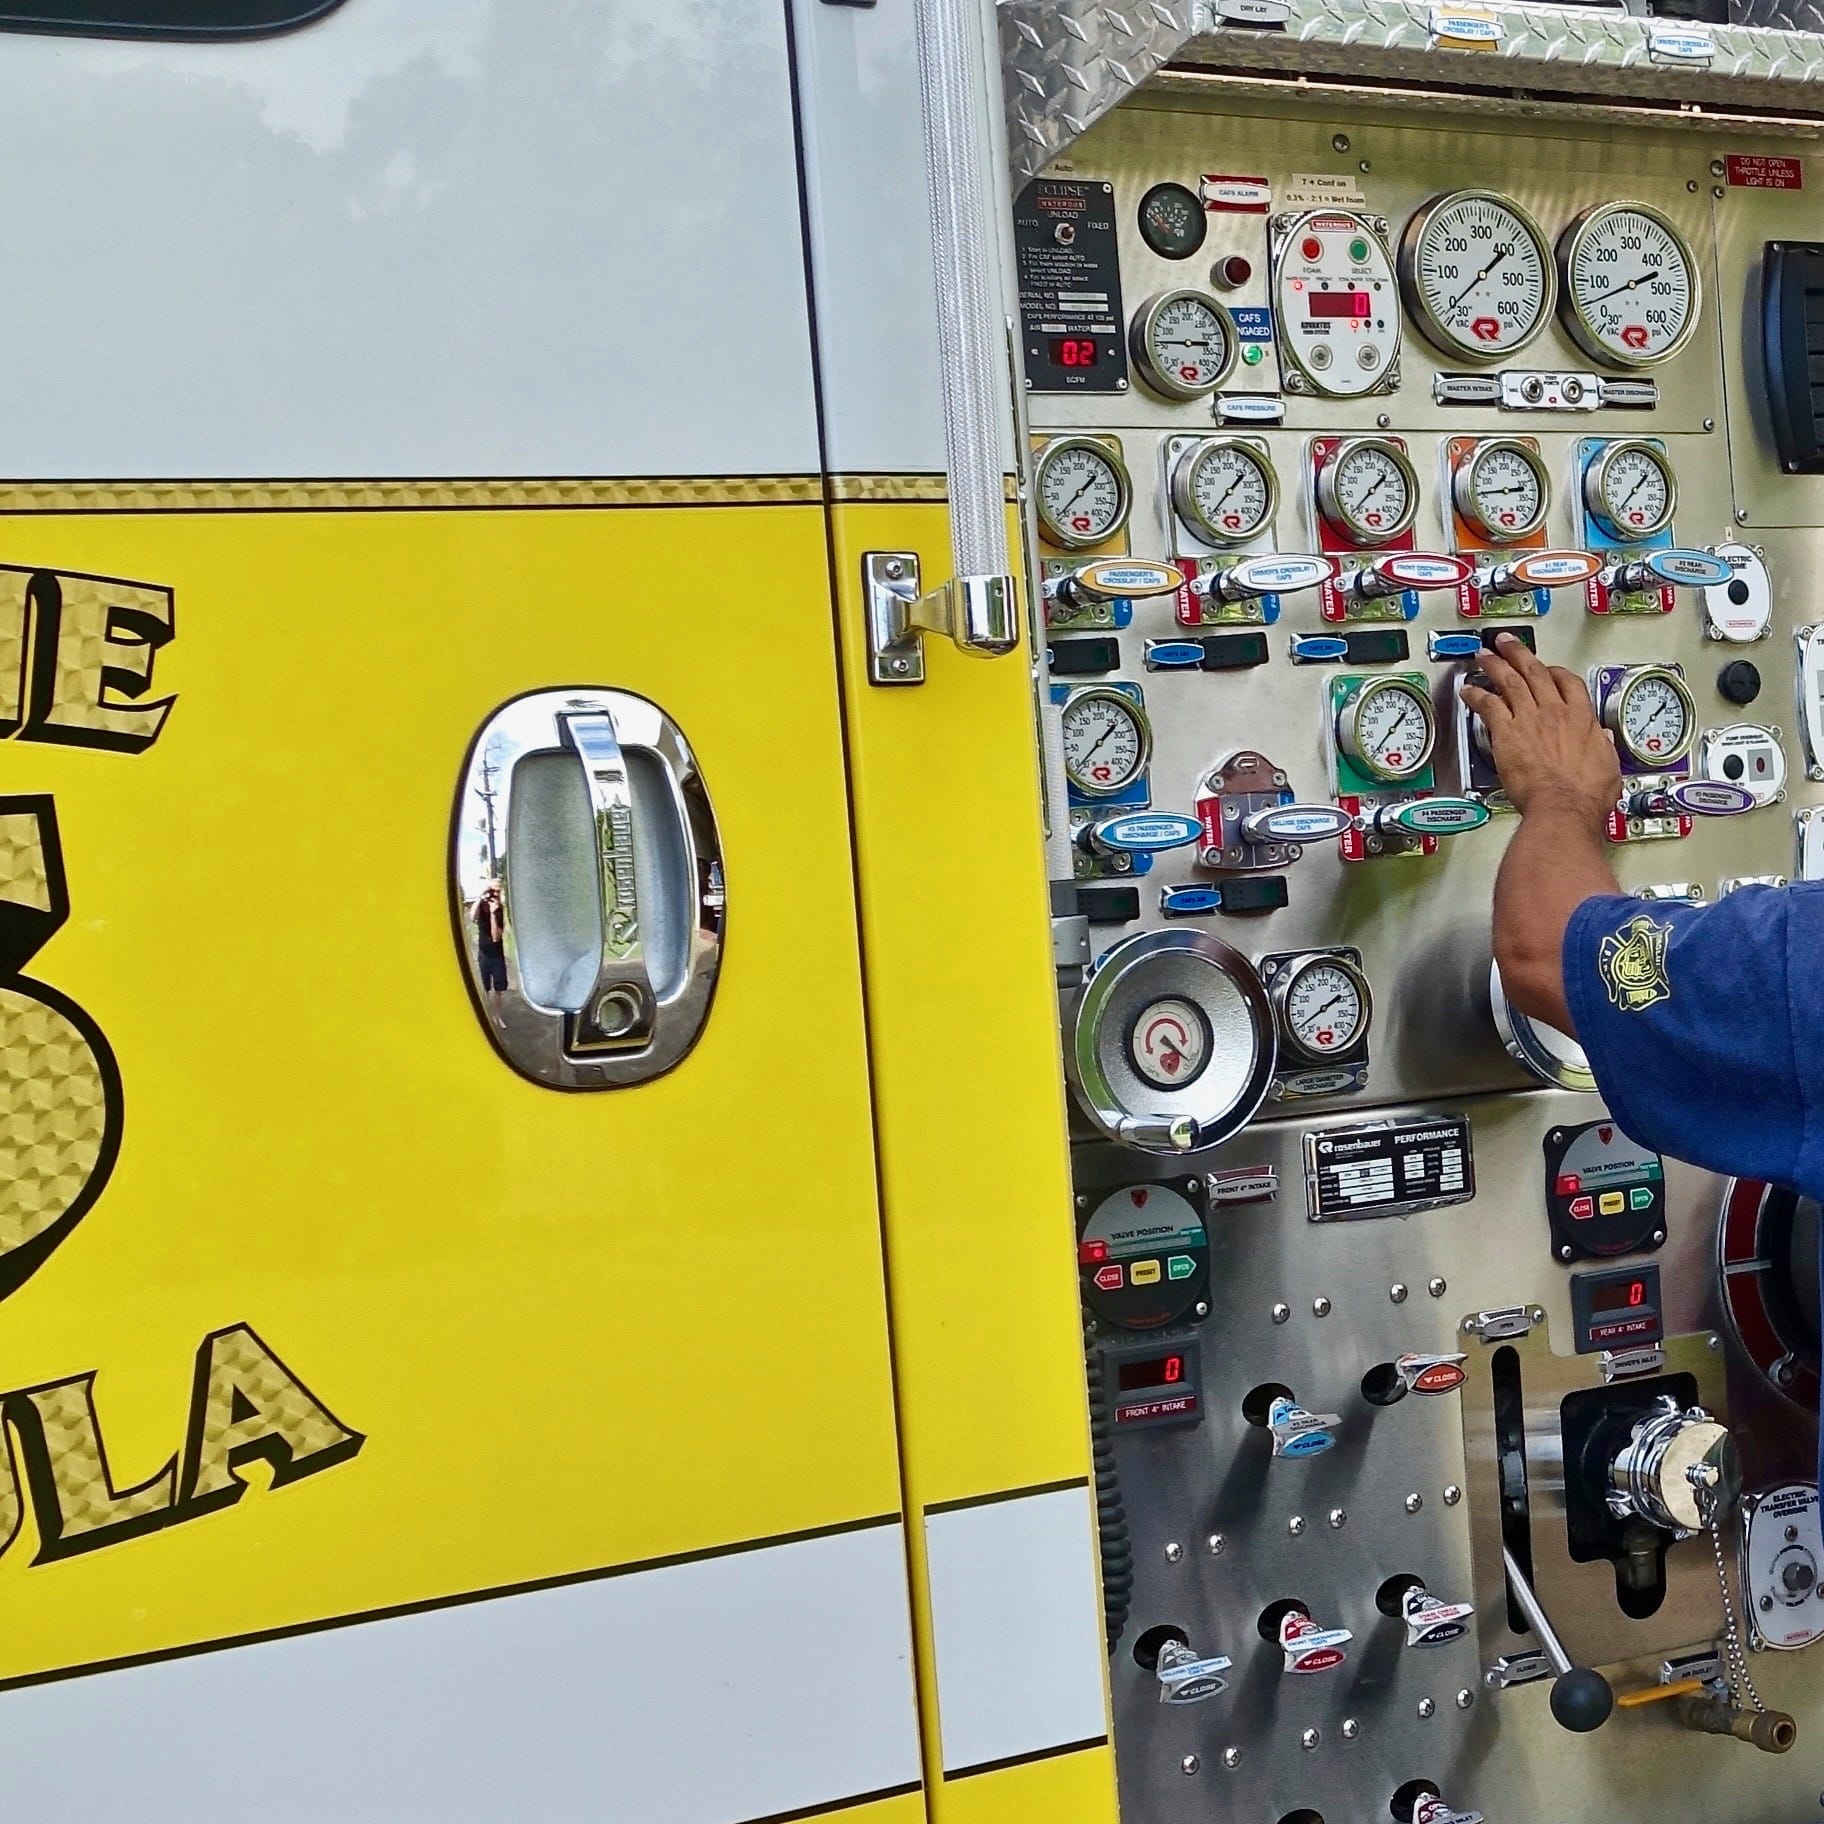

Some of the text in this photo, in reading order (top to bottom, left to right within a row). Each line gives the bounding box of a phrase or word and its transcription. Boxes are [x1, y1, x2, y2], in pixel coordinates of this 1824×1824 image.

[1735, 166, 1794, 177] THROTTLE UNLESS
[1746, 178, 1764, 186] LIGHT
[1470, 225, 1493, 239] 300
[1444, 238, 1468, 252] 200
[1493, 243, 1515, 257] 400
[1620, 236, 1641, 250] 300
[1596, 249, 1618, 262] 200
[1641, 253, 1663, 267] 400
[1437, 265, 1459, 279] 100
[1502, 272, 1524, 286] 500
[1589, 275, 1610, 289] 100
[1650, 283, 1671, 296] 500
[1355, 295, 1367, 315] 0
[1497, 301, 1519, 315] 600
[1600, 304, 1608, 318] 0
[1238, 313, 1261, 323] CAFS
[1646, 310, 1667, 323] 600
[1455, 319, 1470, 329] VAC
[1503, 319, 1514, 330] psi
[1606, 327, 1620, 338] VAC
[1651, 328, 1662, 338] psi
[1062, 340, 1094, 366] 02
[1324, 578, 1335, 615] WATER
[1461, 583, 1470, 611] ATER
[0, 561, 181, 755] E
[1203, 814, 1213, 845] WATER
[1394, 1128, 1460, 1144] PERFORMANCE
[1333, 1138, 1382, 1153] rosenbauer
[1583, 1160, 1635, 1175] VALVE POSITION
[1217, 1185, 1239, 1194] FRONT
[1248, 1181, 1271, 1191] INTAKE
[1634, 1195, 1649, 1203] OPEN
[1573, 1203, 1590, 1213] CLOSE
[1110, 1225, 1174, 1241] VALVE POSITION
[1099, 1272, 1120, 1283] CLOSE
[1629, 1282, 1643, 1305] 0
[1164, 1357, 1181, 1381] 0
[1433, 1372, 1457, 1384] CLOSE
[1125, 1406, 1150, 1418] FRONT
[1161, 1399, 1187, 1412] INTAKE
[0, 1322, 367, 1568] LA
[1301, 1439, 1326, 1450] CLOSE
[1773, 1490, 1807, 1503] ELECTRIC
[1761, 1495, 1819, 1514] TRANSFER VALVE
[1773, 1505, 1808, 1518] OVERRIDE
[1436, 1628, 1460, 1639] CLOSE
[1312, 1654, 1337, 1666] CLOSE
[1190, 1683, 1216, 1694] CLOSE
